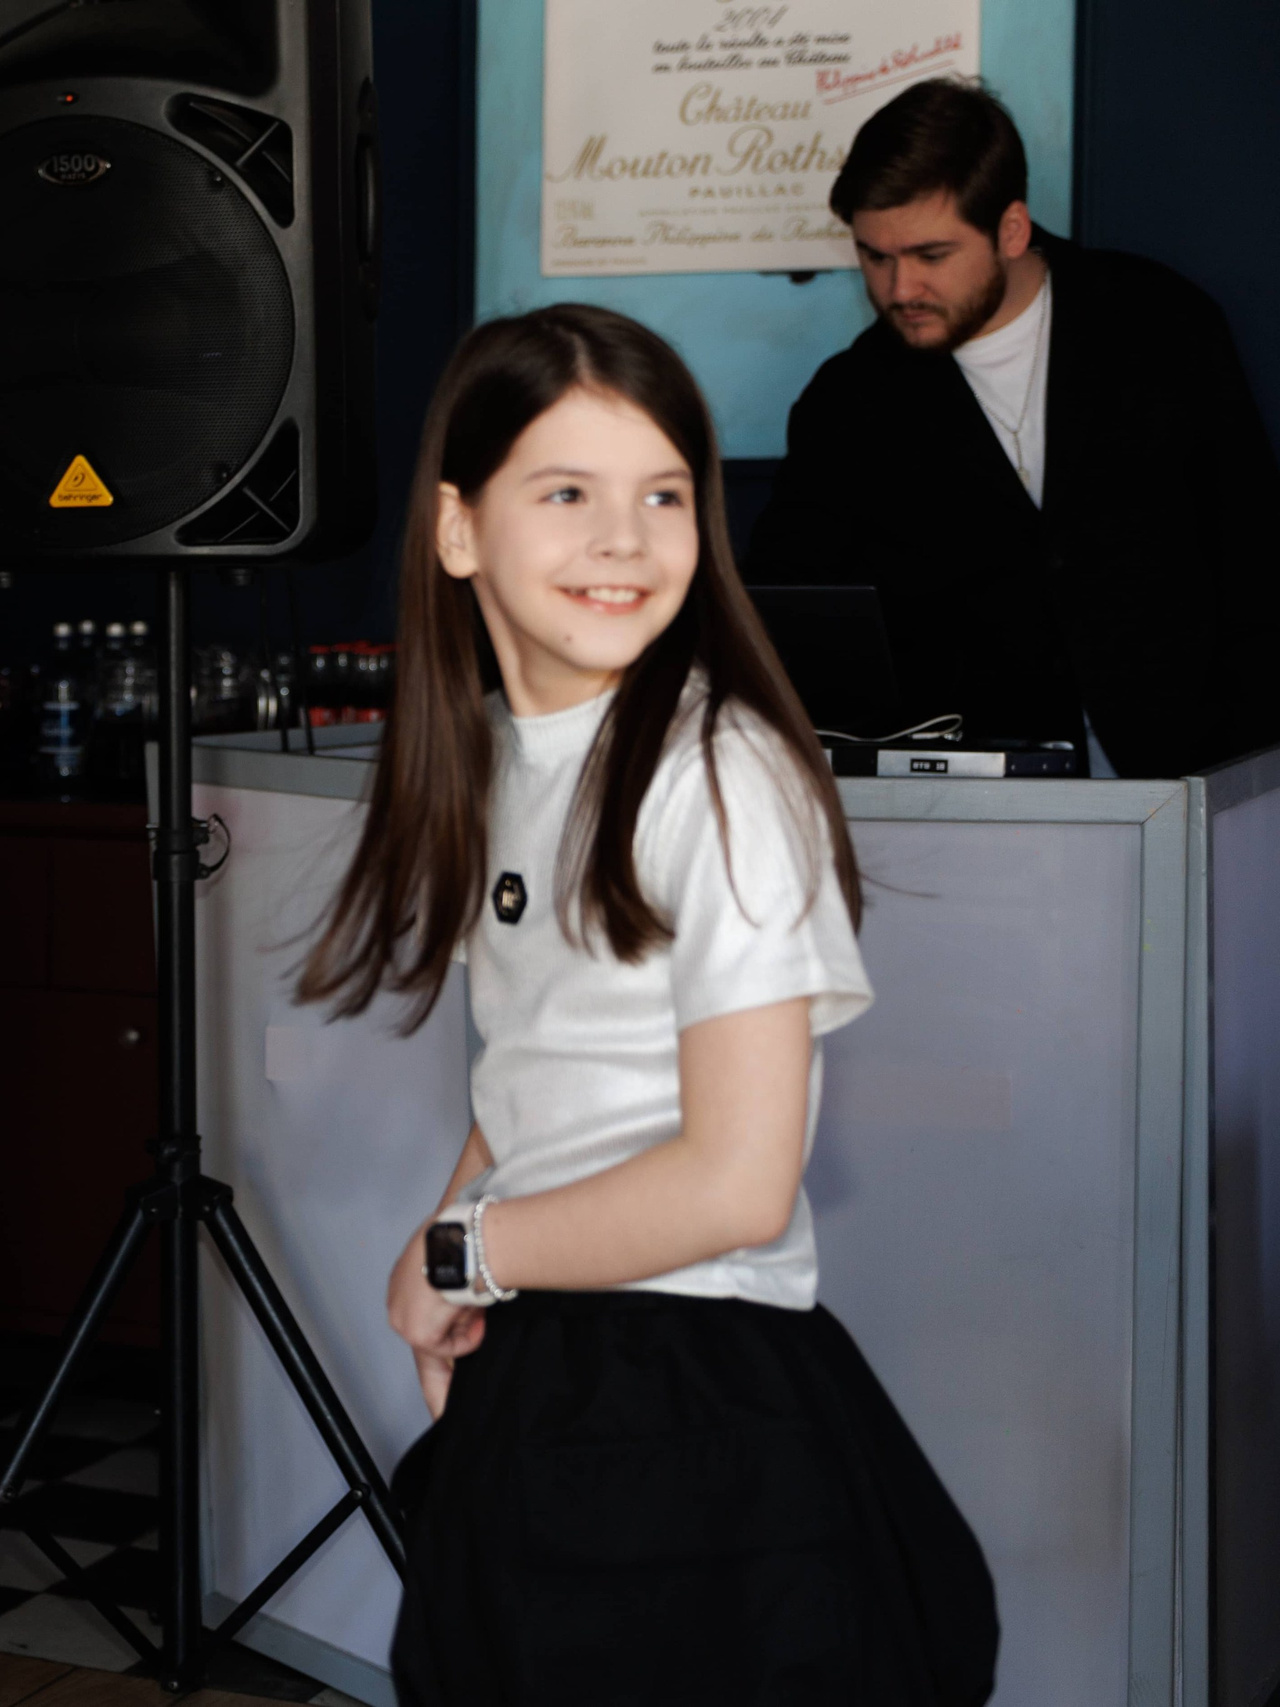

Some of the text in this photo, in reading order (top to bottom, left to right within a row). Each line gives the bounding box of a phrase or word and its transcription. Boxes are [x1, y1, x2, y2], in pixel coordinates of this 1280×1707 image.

[678, 81, 812, 126] Château
[52, 153, 95, 173] 1500
[546, 124, 847, 183] Mouton Roths
[58, 493, 103, 504] behringer
